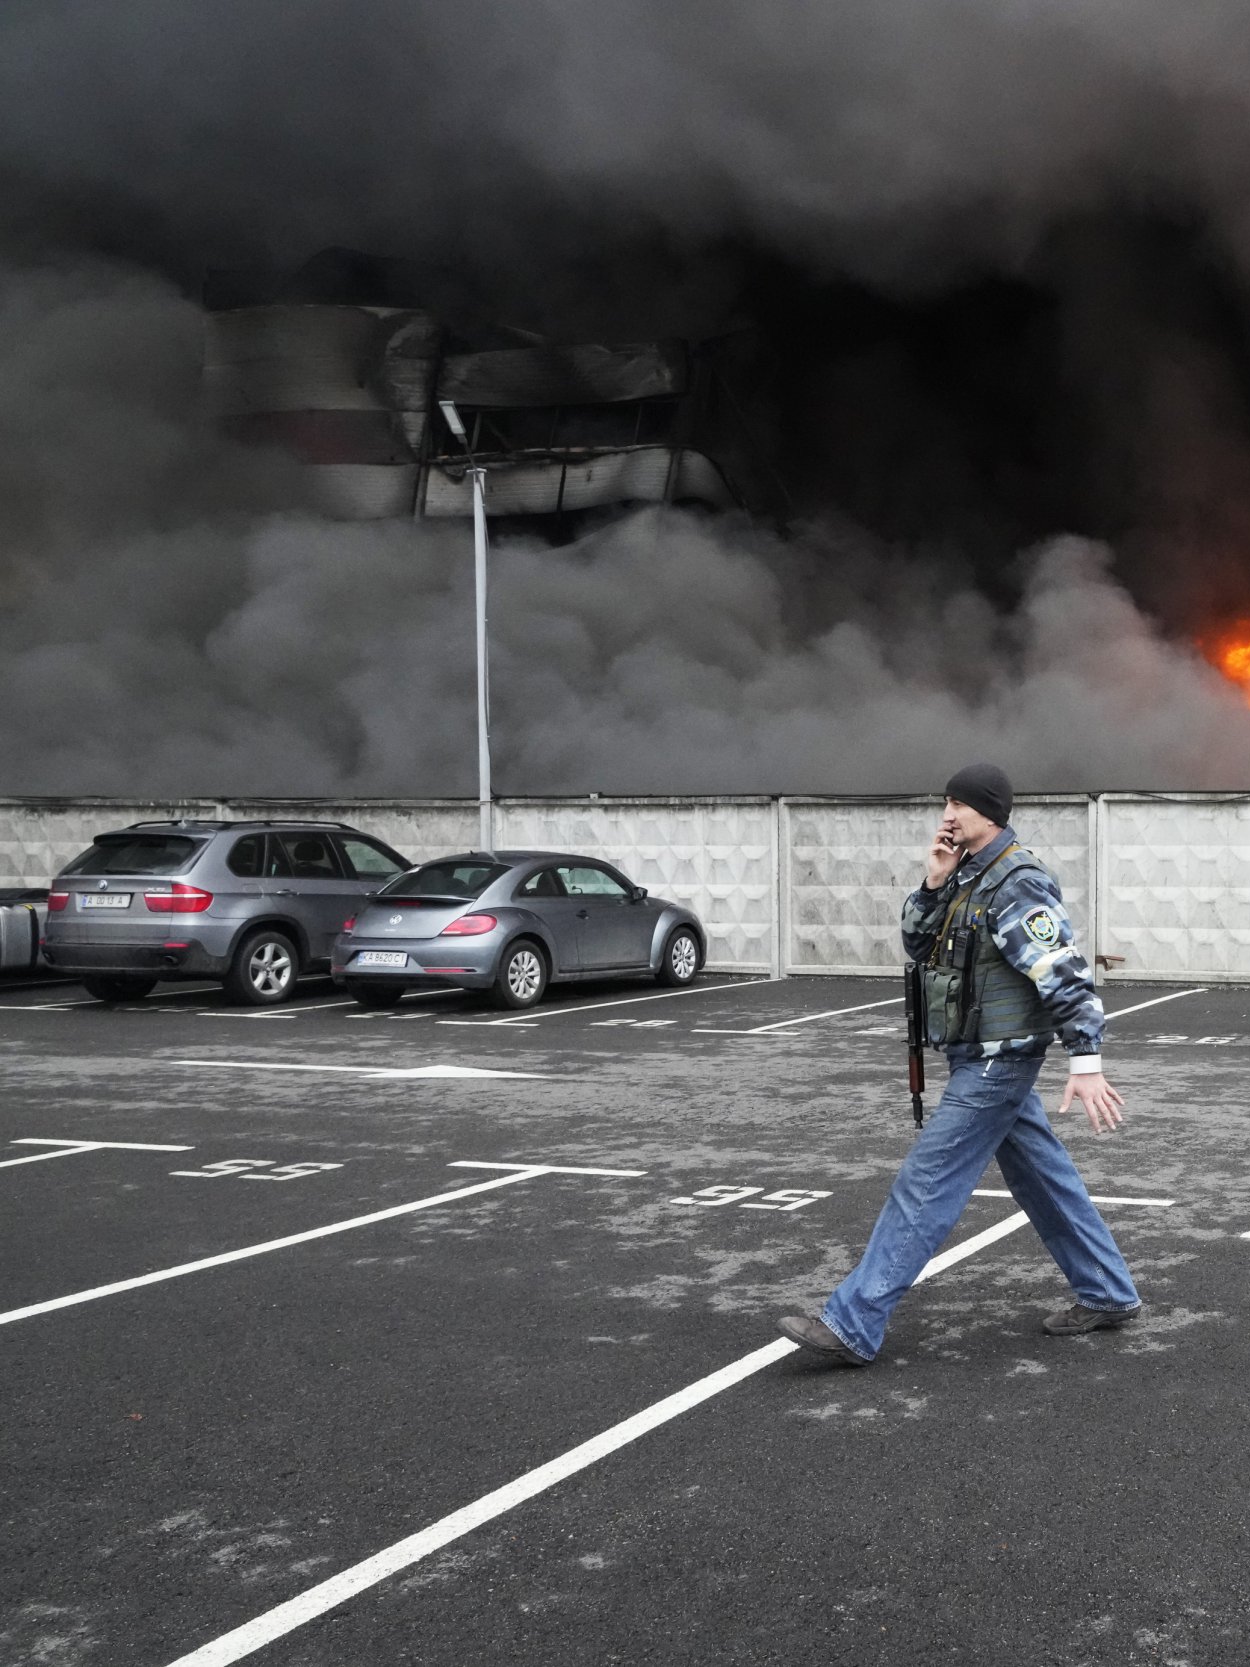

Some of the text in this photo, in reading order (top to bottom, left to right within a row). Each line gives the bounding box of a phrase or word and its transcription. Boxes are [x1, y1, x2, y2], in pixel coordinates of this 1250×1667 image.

[588, 1018, 679, 1029] 28
[853, 1026, 899, 1035] 2
[1146, 1035, 1237, 1045] 26
[168, 1159, 344, 1181] 55
